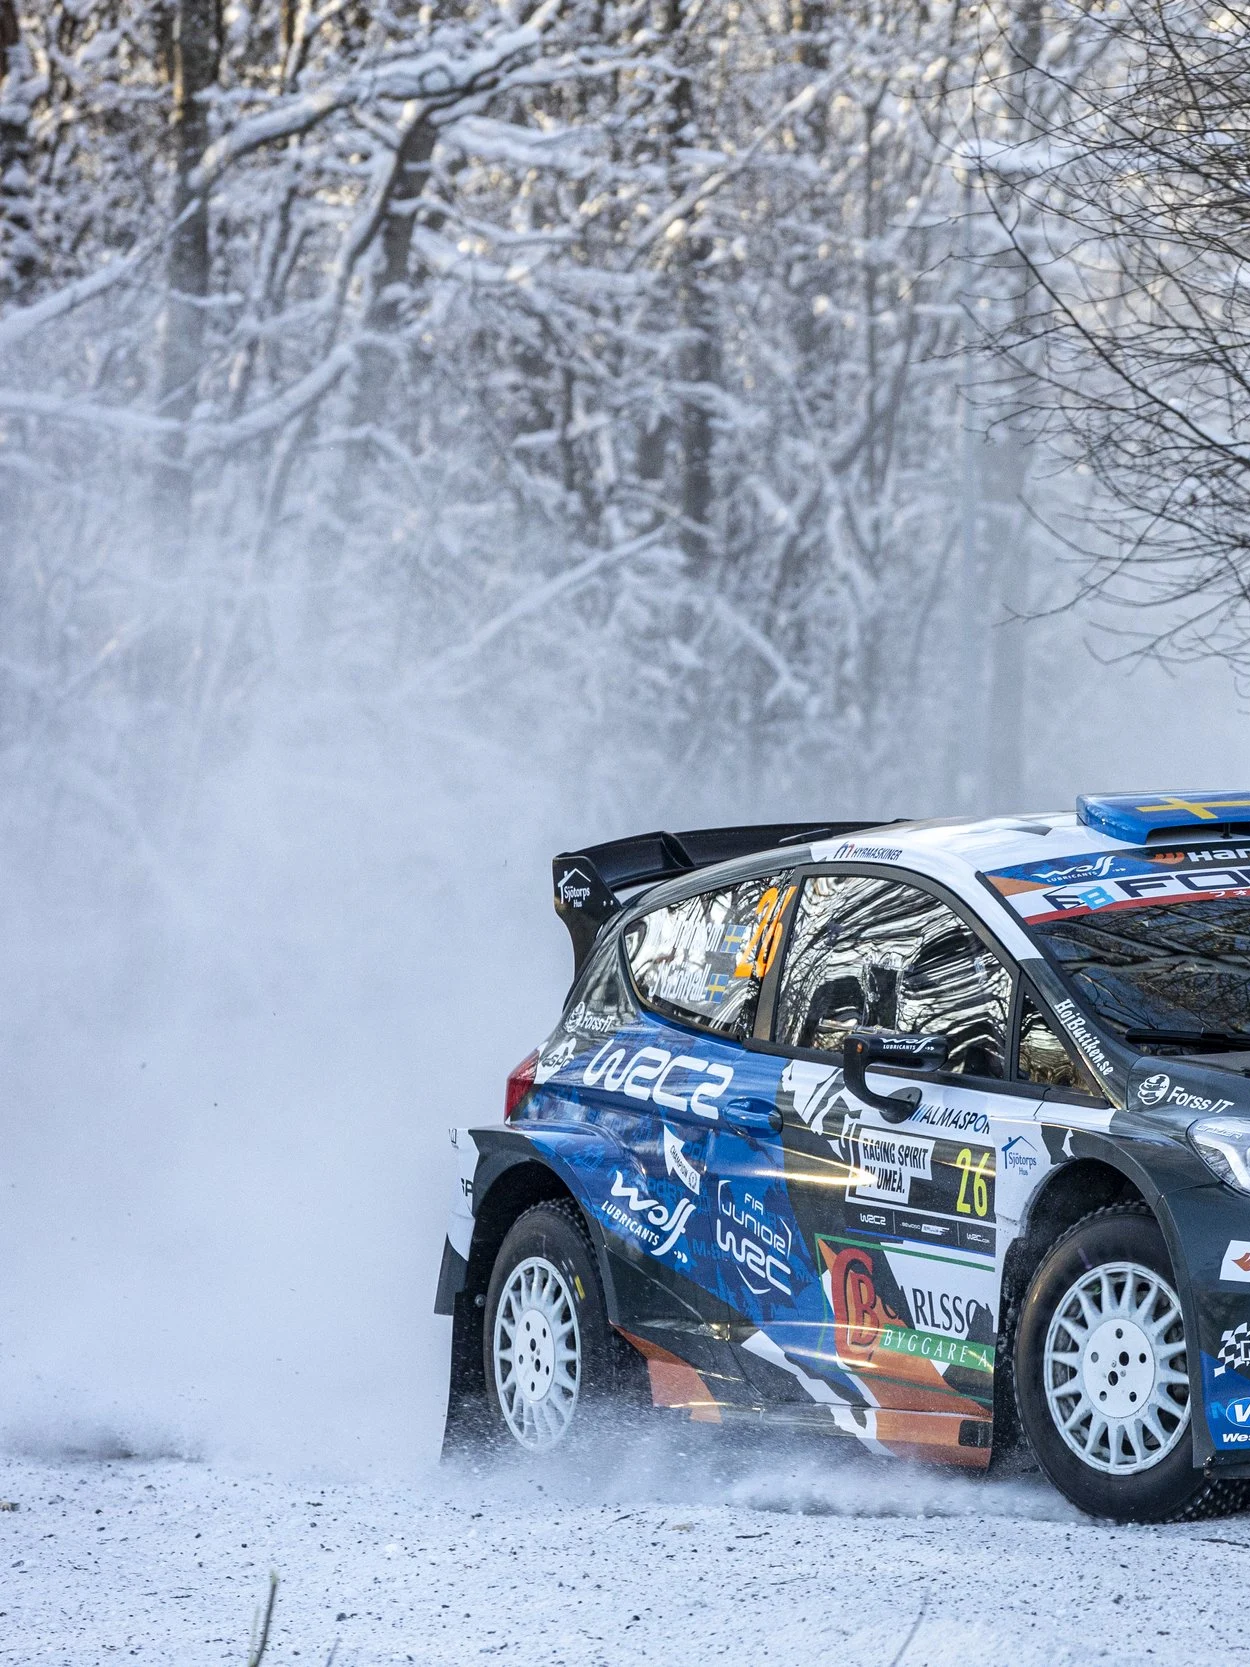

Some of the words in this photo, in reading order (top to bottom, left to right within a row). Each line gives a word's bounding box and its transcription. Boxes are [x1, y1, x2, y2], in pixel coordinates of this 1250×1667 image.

[1046, 870, 1098, 883] LUBRICANTS
[1166, 1085, 1210, 1110] Forss
[1208, 1099, 1235, 1113] IT
[669, 1144, 689, 1180] CHAMPION
[863, 1137, 896, 1164] RACING
[898, 1144, 929, 1170] SPIRIT
[1008, 1151, 1037, 1170] Sjötorps
[956, 1148, 989, 1217] 26
[1018, 1167, 1029, 1176] Hus
[744, 1192, 764, 1215] FIA
[601, 1200, 661, 1247] LUBRICANTS
[721, 1201, 786, 1255] JUNIOR
[716, 1218, 792, 1296] WRC
[883, 1328, 969, 1364] BYGGARE
